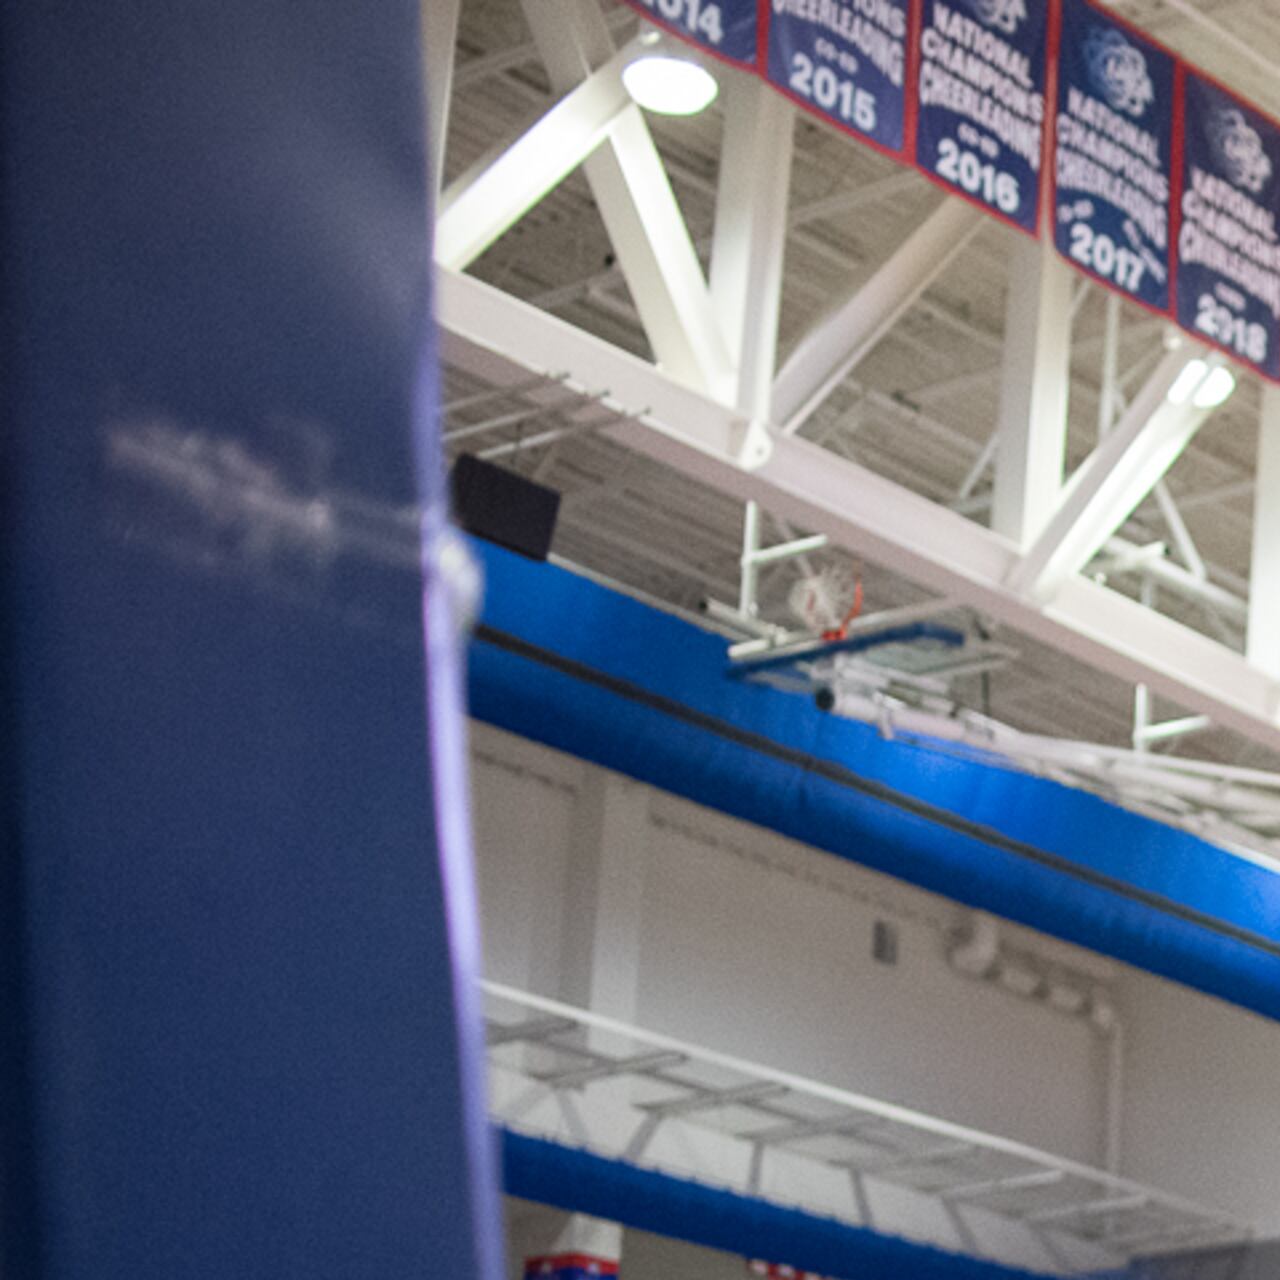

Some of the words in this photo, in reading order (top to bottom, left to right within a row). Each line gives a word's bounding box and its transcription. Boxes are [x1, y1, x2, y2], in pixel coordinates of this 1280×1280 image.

[921, 28, 1044, 126] CHAMPIONS
[932, 2, 1035, 89] NATIONAL
[789, 52, 877, 132] 2015
[936, 138, 1020, 213] 2016
[1069, 222, 1147, 291] 2017
[1195, 293, 1268, 362] 2018
